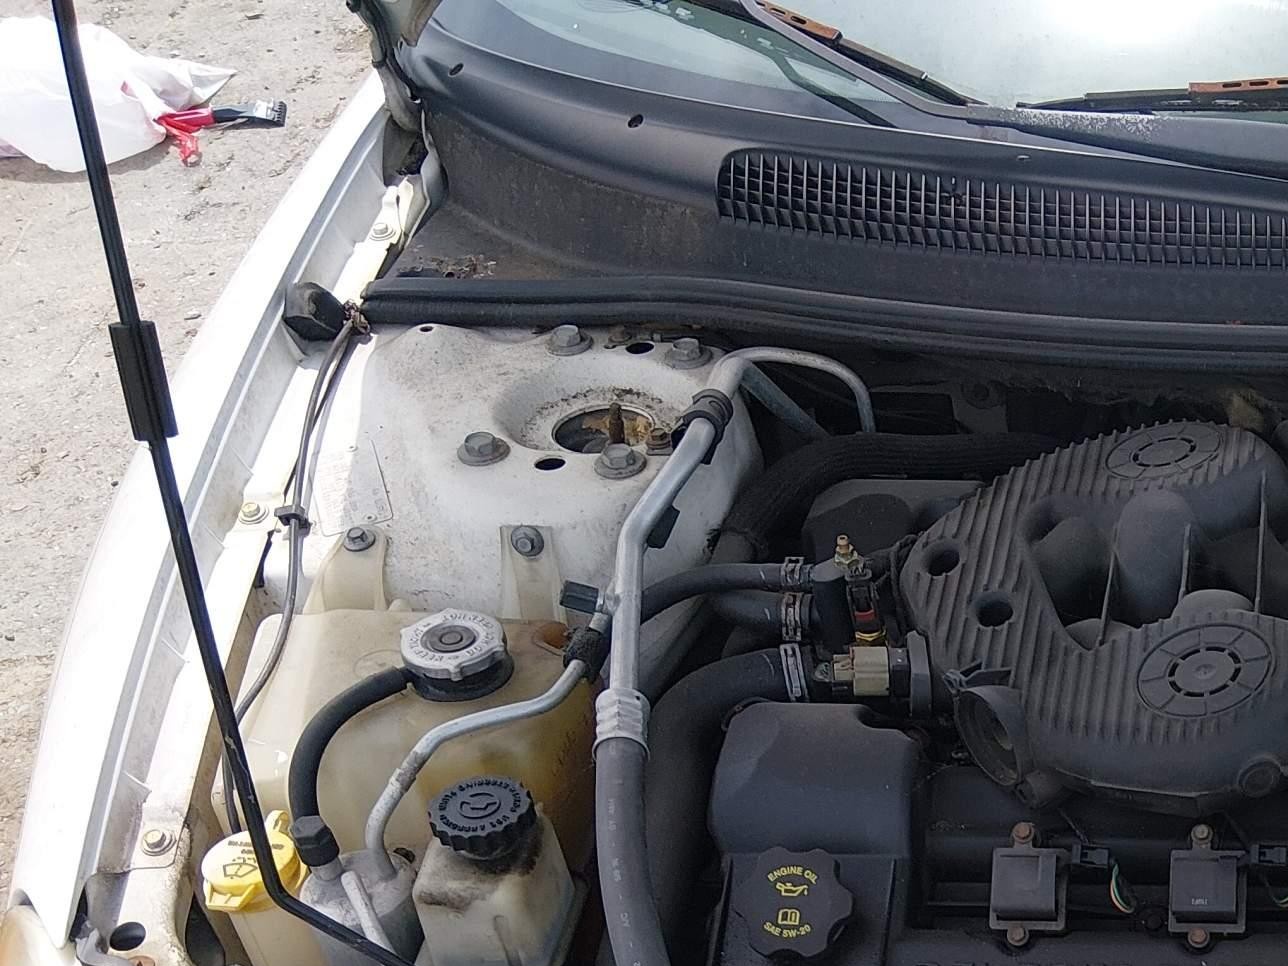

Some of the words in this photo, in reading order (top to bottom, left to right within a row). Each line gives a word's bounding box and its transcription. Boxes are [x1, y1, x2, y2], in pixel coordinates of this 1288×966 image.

[767, 865, 803, 882] ENGINE
[803, 869, 819, 885] OIL
[763, 921, 782, 936] SAE
[782, 923, 811, 938] 5W-20
